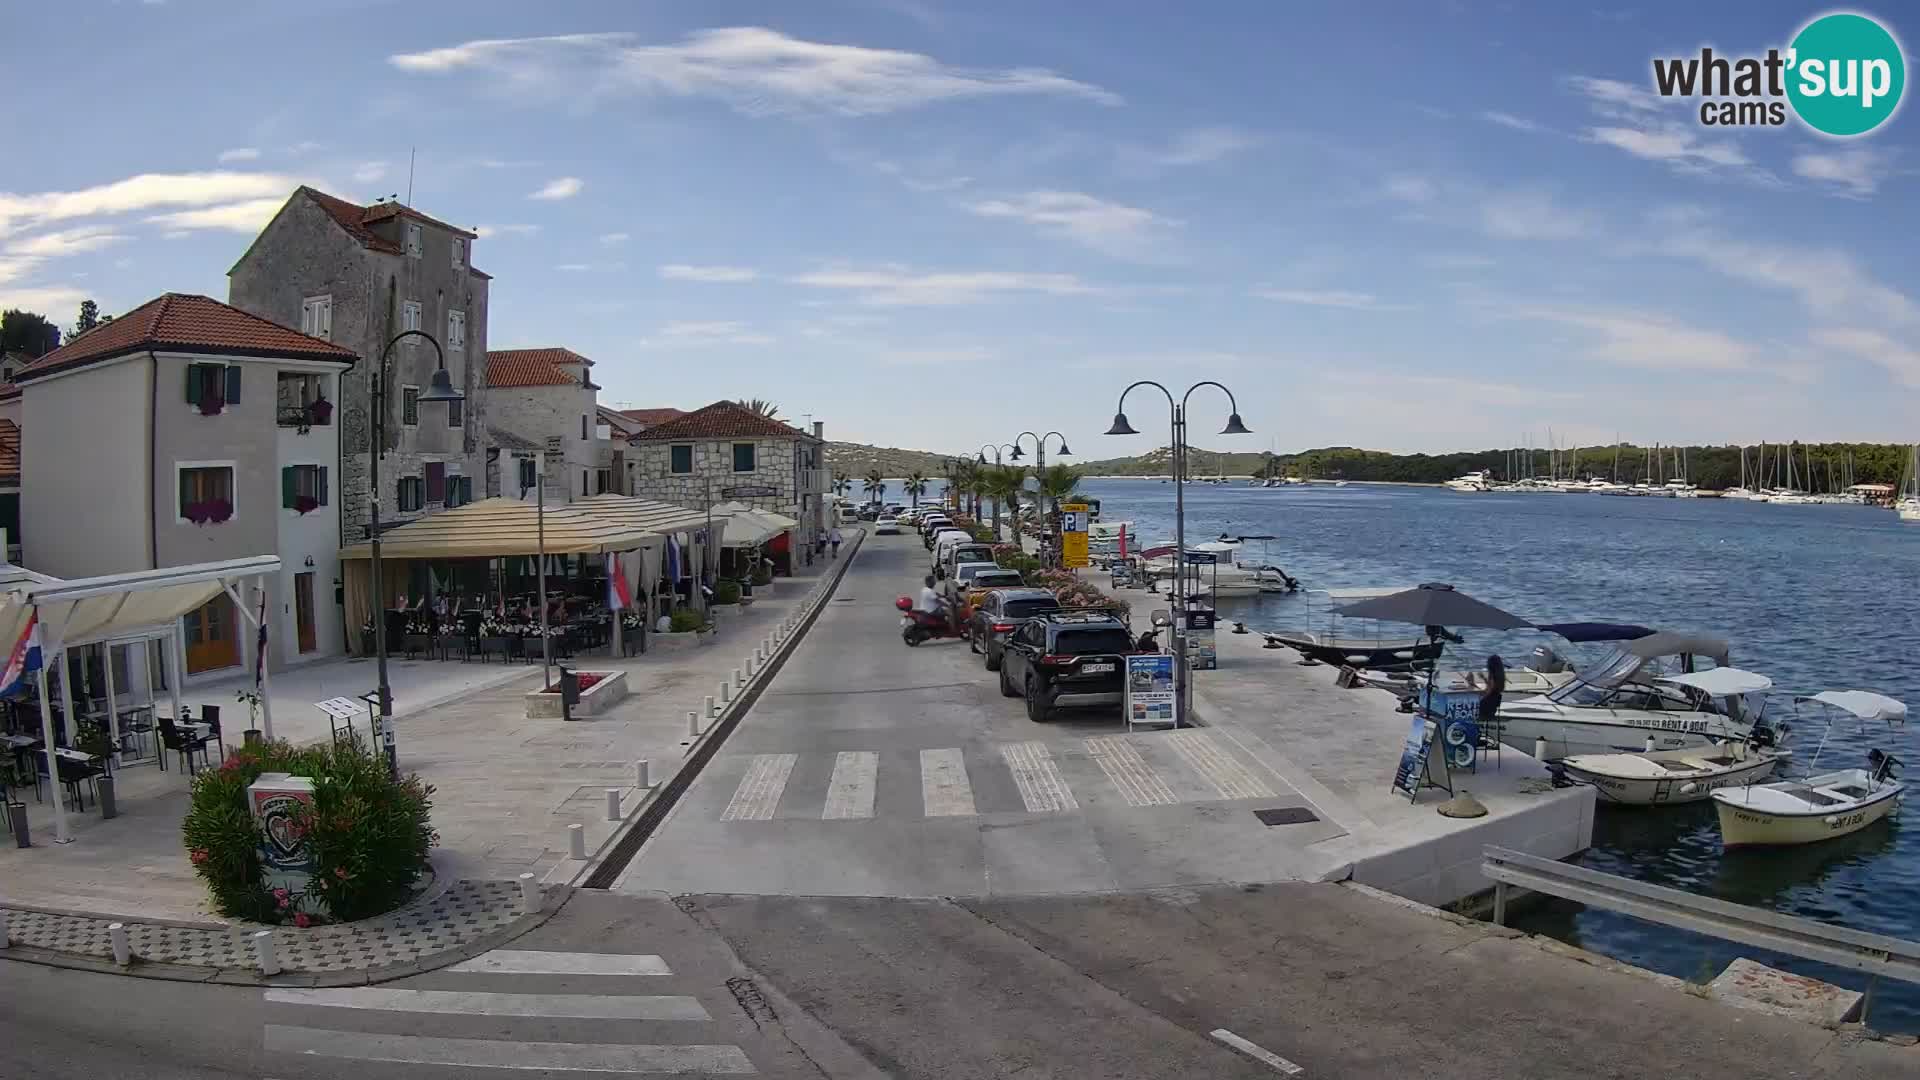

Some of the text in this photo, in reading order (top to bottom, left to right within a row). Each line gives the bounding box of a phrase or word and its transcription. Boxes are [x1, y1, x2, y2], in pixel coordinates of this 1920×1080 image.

[1064, 513, 1075, 531] P
[1447, 697, 1479, 710] RENT
[1661, 719, 1682, 729] RENT
[1689, 720, 1708, 732] BOAT
